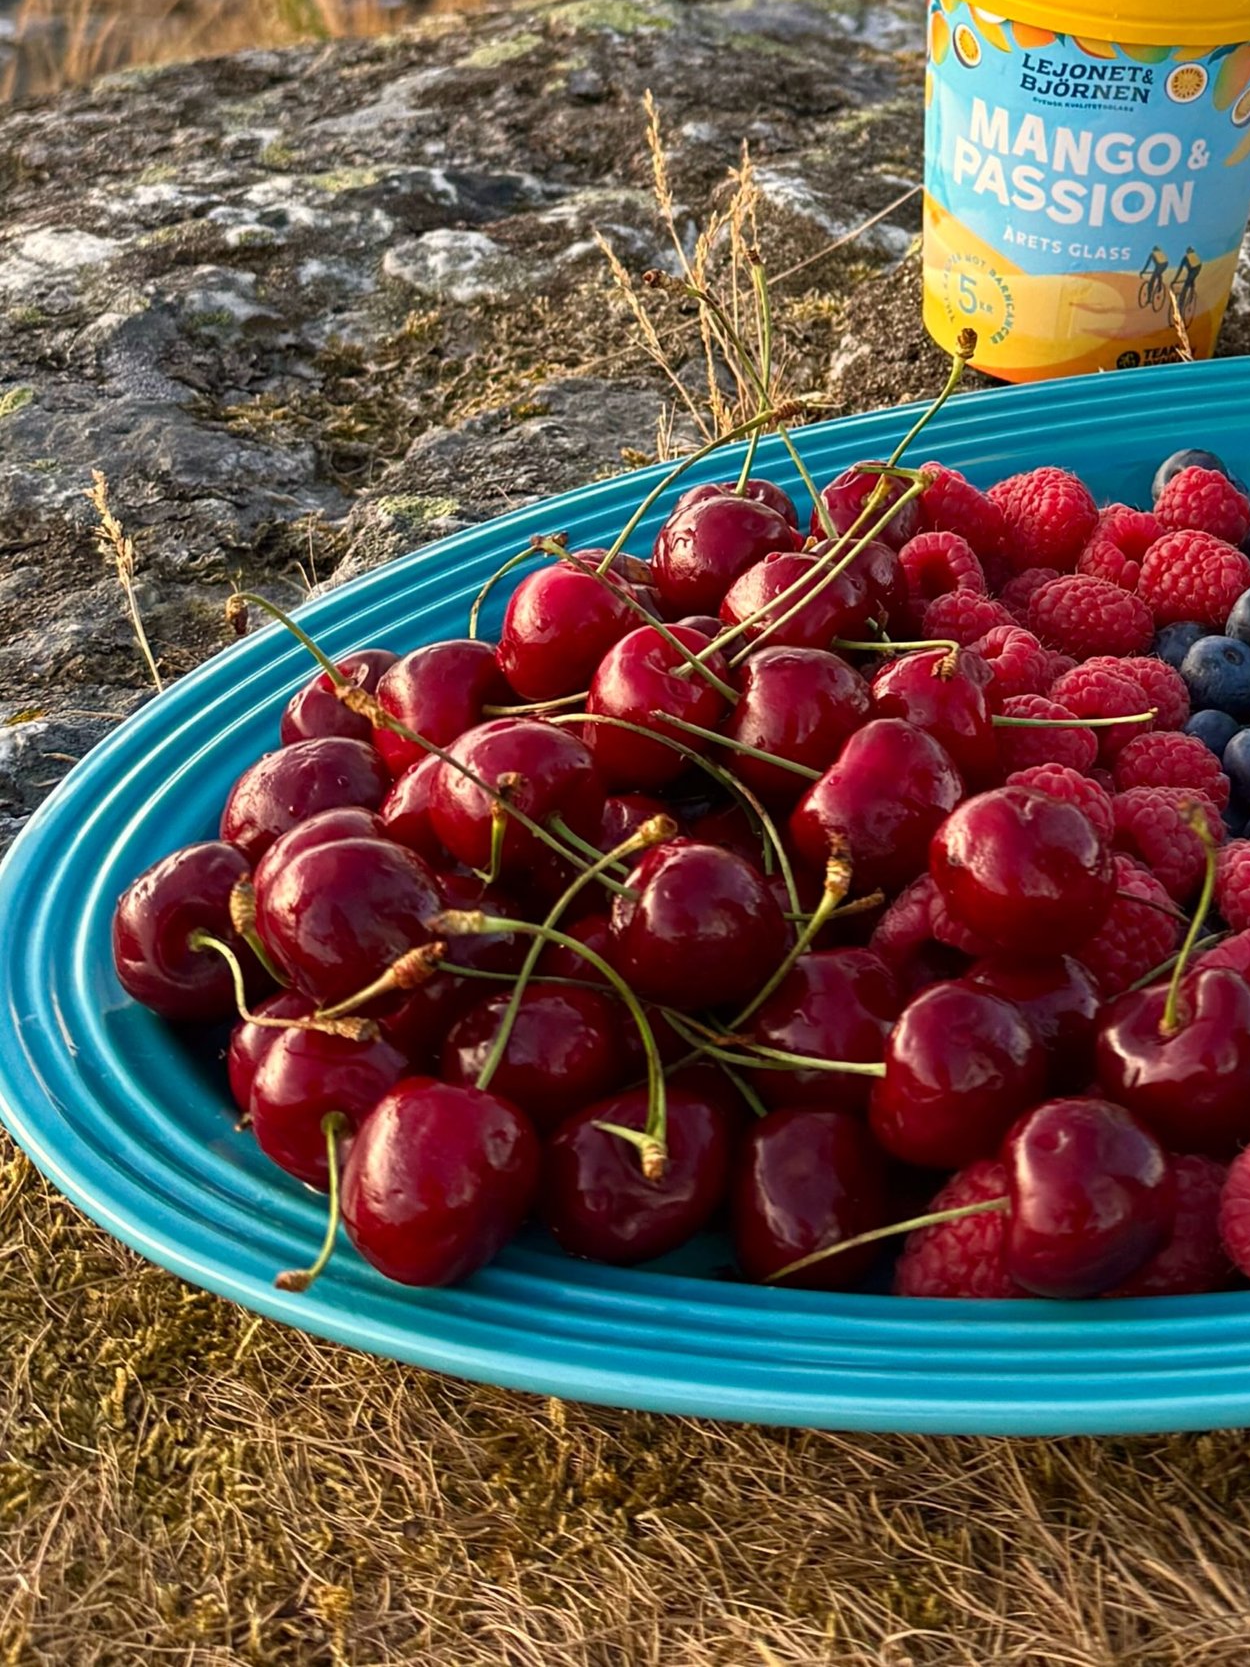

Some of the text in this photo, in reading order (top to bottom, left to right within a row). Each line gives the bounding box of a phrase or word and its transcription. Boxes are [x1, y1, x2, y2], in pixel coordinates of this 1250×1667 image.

[1019, 72, 1151, 104] BJÖRNEN
[952, 135, 1195, 228] PASSION
[1068, 242, 1132, 261] GLASS
[959, 273, 977, 314] 5
